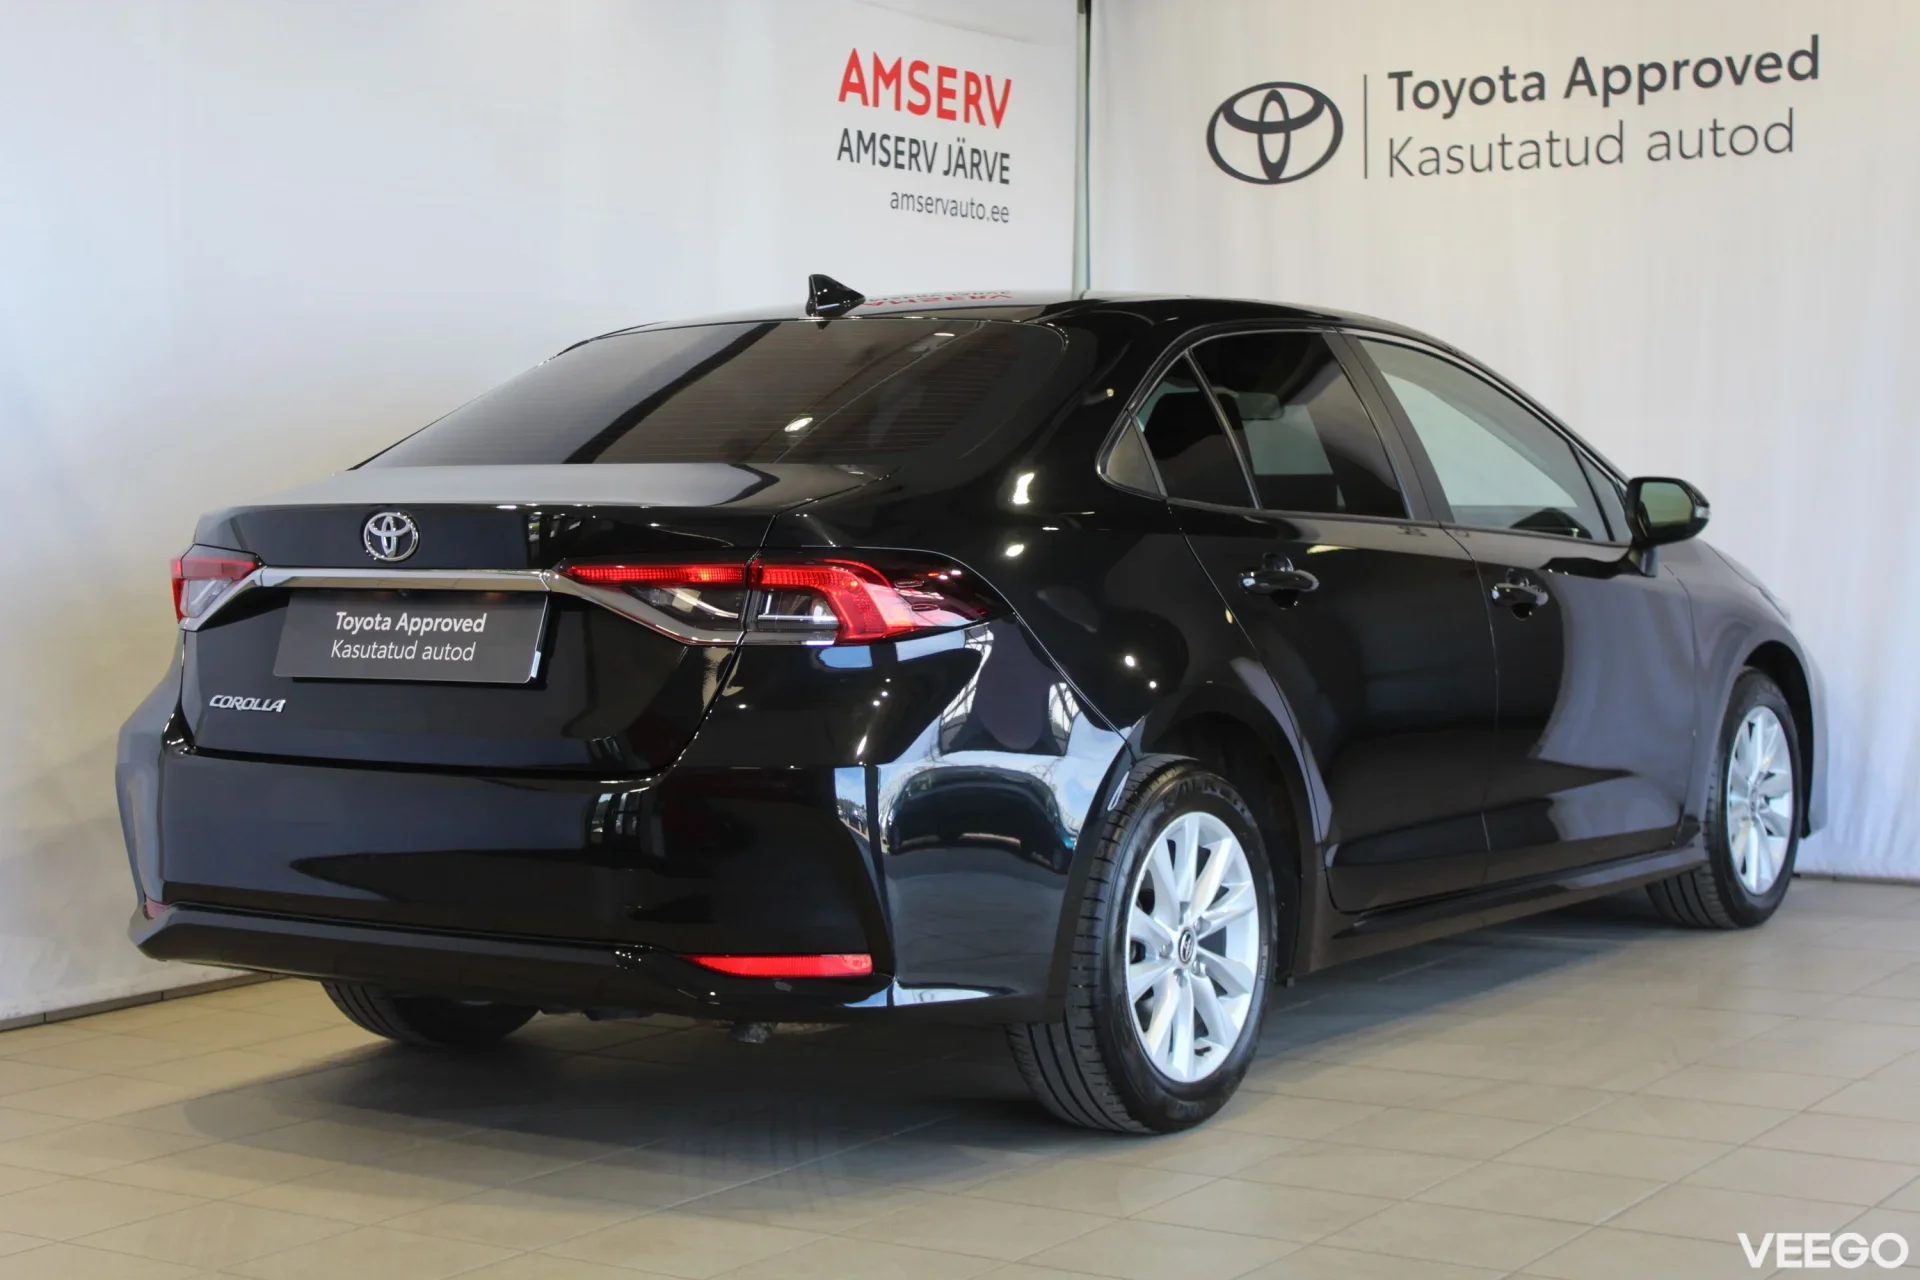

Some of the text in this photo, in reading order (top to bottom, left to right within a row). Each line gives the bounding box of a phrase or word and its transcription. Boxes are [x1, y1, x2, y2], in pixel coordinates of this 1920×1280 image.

[838, 47, 1012, 129] AMSERV
[1387, 34, 1819, 119] Toyota Approved
[836, 127, 1011, 184] AMSERV JÄRVE
[1389, 107, 1794, 177] Kasutatud autod
[889, 191, 1010, 223] amservauto.ee
[335, 611, 488, 637] Toyota Approved
[330, 639, 477, 662] Kasutatud autod
[208, 694, 287, 713] COROLLA
